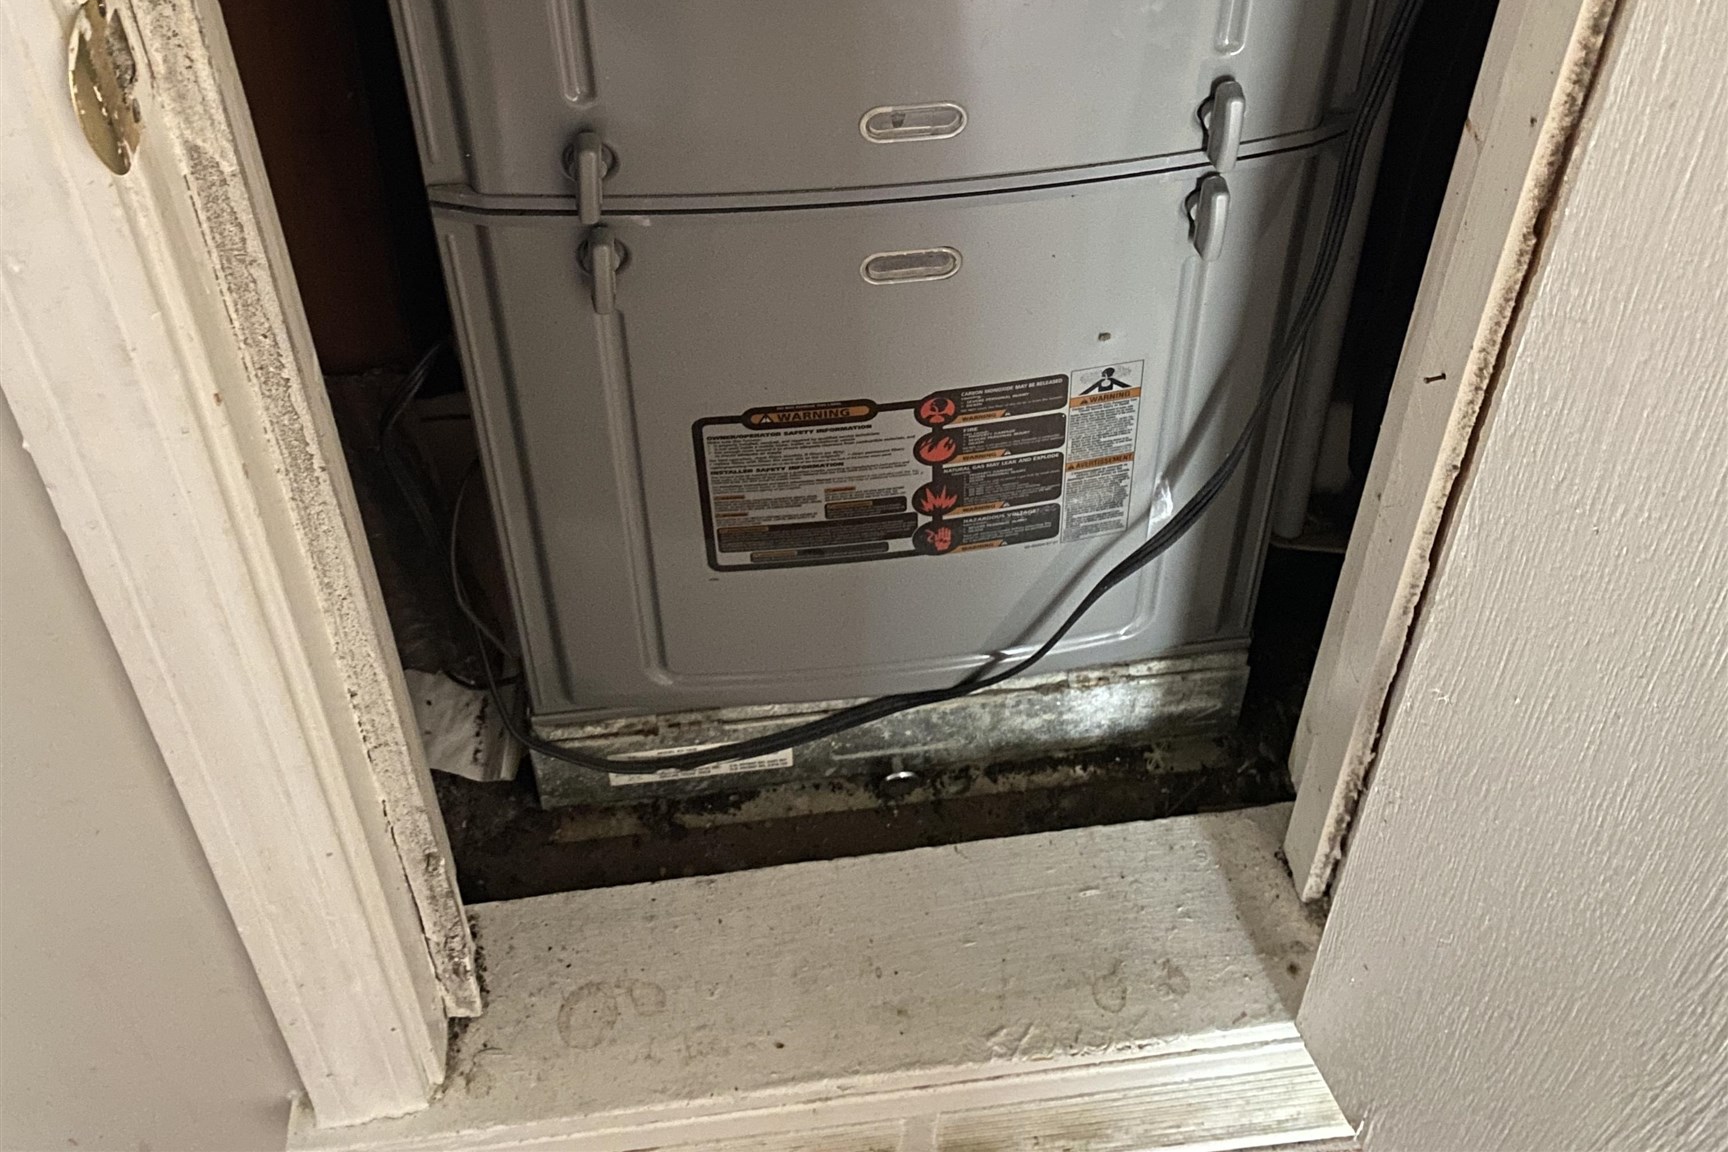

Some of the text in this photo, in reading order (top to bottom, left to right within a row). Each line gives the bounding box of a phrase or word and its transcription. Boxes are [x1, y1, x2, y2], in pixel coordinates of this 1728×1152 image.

[1036, 378, 1064, 387] RELEASED
[1089, 390, 1131, 403] WARNING
[777, 408, 851, 423] WARNING
[962, 412, 998, 422] WARNING
[706, 423, 873, 441] OWNER/OPERATOR SAFETY INFORMATION
[962, 452, 997, 461] WARNING
[1075, 453, 1133, 469] AVERTISSEMENT
[756, 465, 786, 474] SAFETY
[788, 461, 844, 471] INFORMATION
[943, 466, 971, 474] NATURAL
[1032, 453, 1060, 461] EXPLODE
[963, 514, 1005, 524] HAZARDOUS
